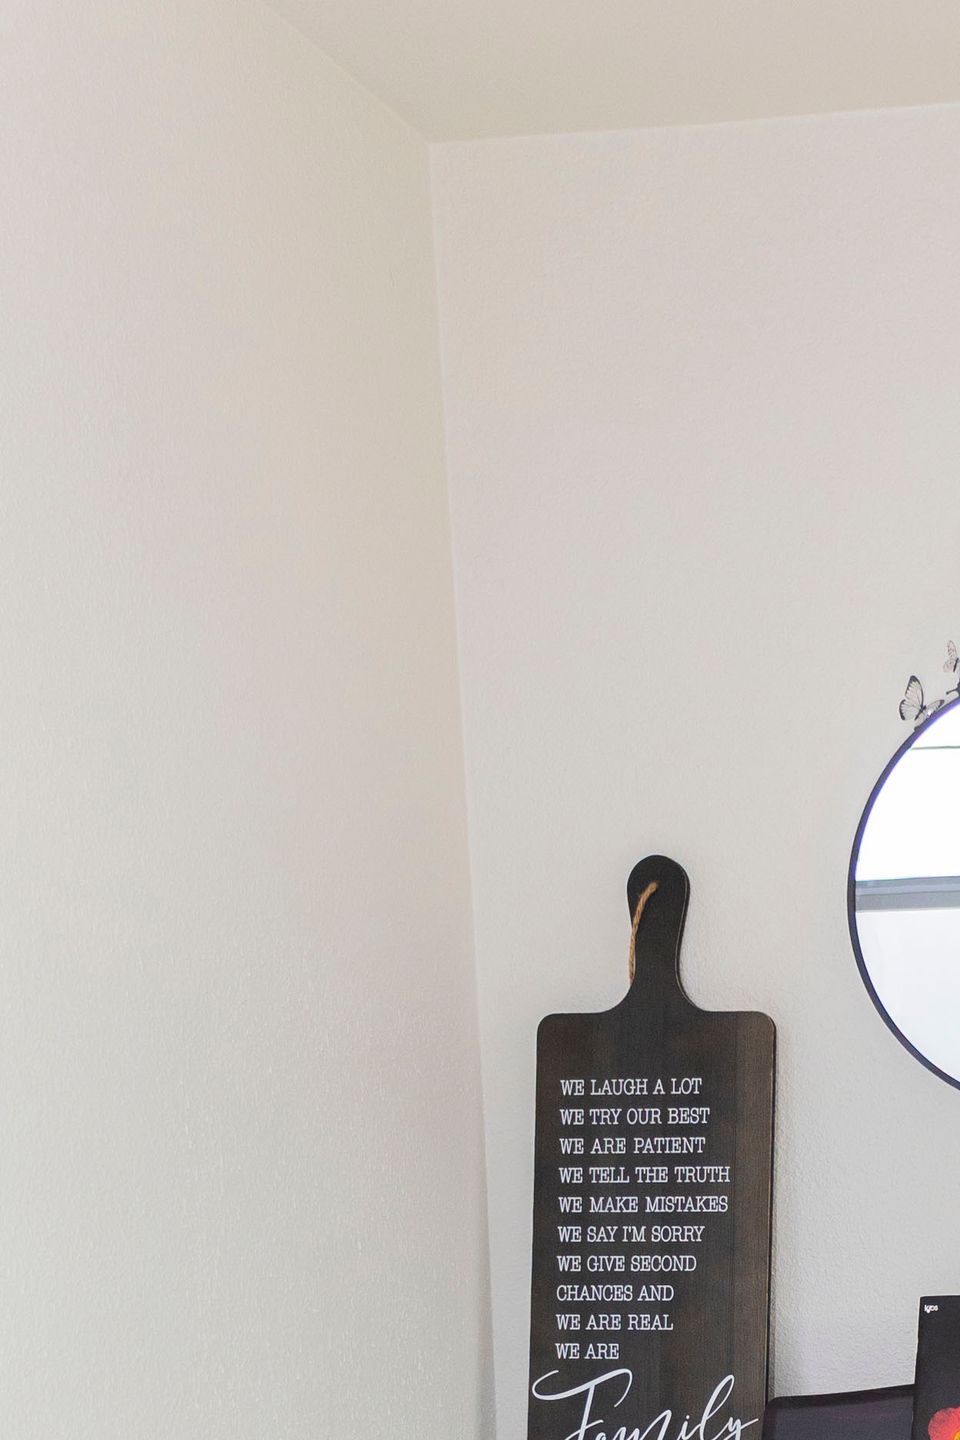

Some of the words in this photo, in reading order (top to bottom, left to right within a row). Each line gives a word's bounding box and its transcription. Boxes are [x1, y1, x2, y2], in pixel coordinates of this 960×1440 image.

[560, 1080, 584, 1095] WE
[591, 1079, 648, 1095] LAUGH
[653, 1079, 665, 1094] A
[671, 1078, 702, 1094] LOT
[560, 1109, 584, 1125] WE
[590, 1109, 622, 1124] TRY
[627, 1108, 662, 1124] OUR
[668, 1108, 710, 1124] BEST
[559, 1138, 583, 1154] WE
[590, 1138, 625, 1154] ARE
[634, 1137, 705, 1153] PATIENT
[559, 1168, 582, 1183] WE
[589, 1167, 629, 1183] TELL
[635, 1167, 668, 1182] THE
[675, 1166, 730, 1182] TRUTH
[559, 1197, 582, 1212] WE
[590, 1197, 638, 1212] MAKE
[645, 1196, 728, 1212] MISTAKES
[558, 1226, 581, 1242] WE
[587, 1226, 618, 1242] SAY
[622, 1226, 646, 1242] I'M
[652, 1226, 705, 1242] SORRY
[557, 1256, 581, 1271] WE
[587, 1256, 625, 1271] GIVE
[631, 1255, 696, 1271] SECOND
[557, 1285, 632, 1301] CHANCES
[637, 1285, 674, 1301] AND
[556, 1314, 580, 1330] WE
[586, 1315, 621, 1330] ARE
[628, 1314, 673, 1330] REAL
[555, 1343, 579, 1359] WE
[584, 1344, 619, 1359] ARE
